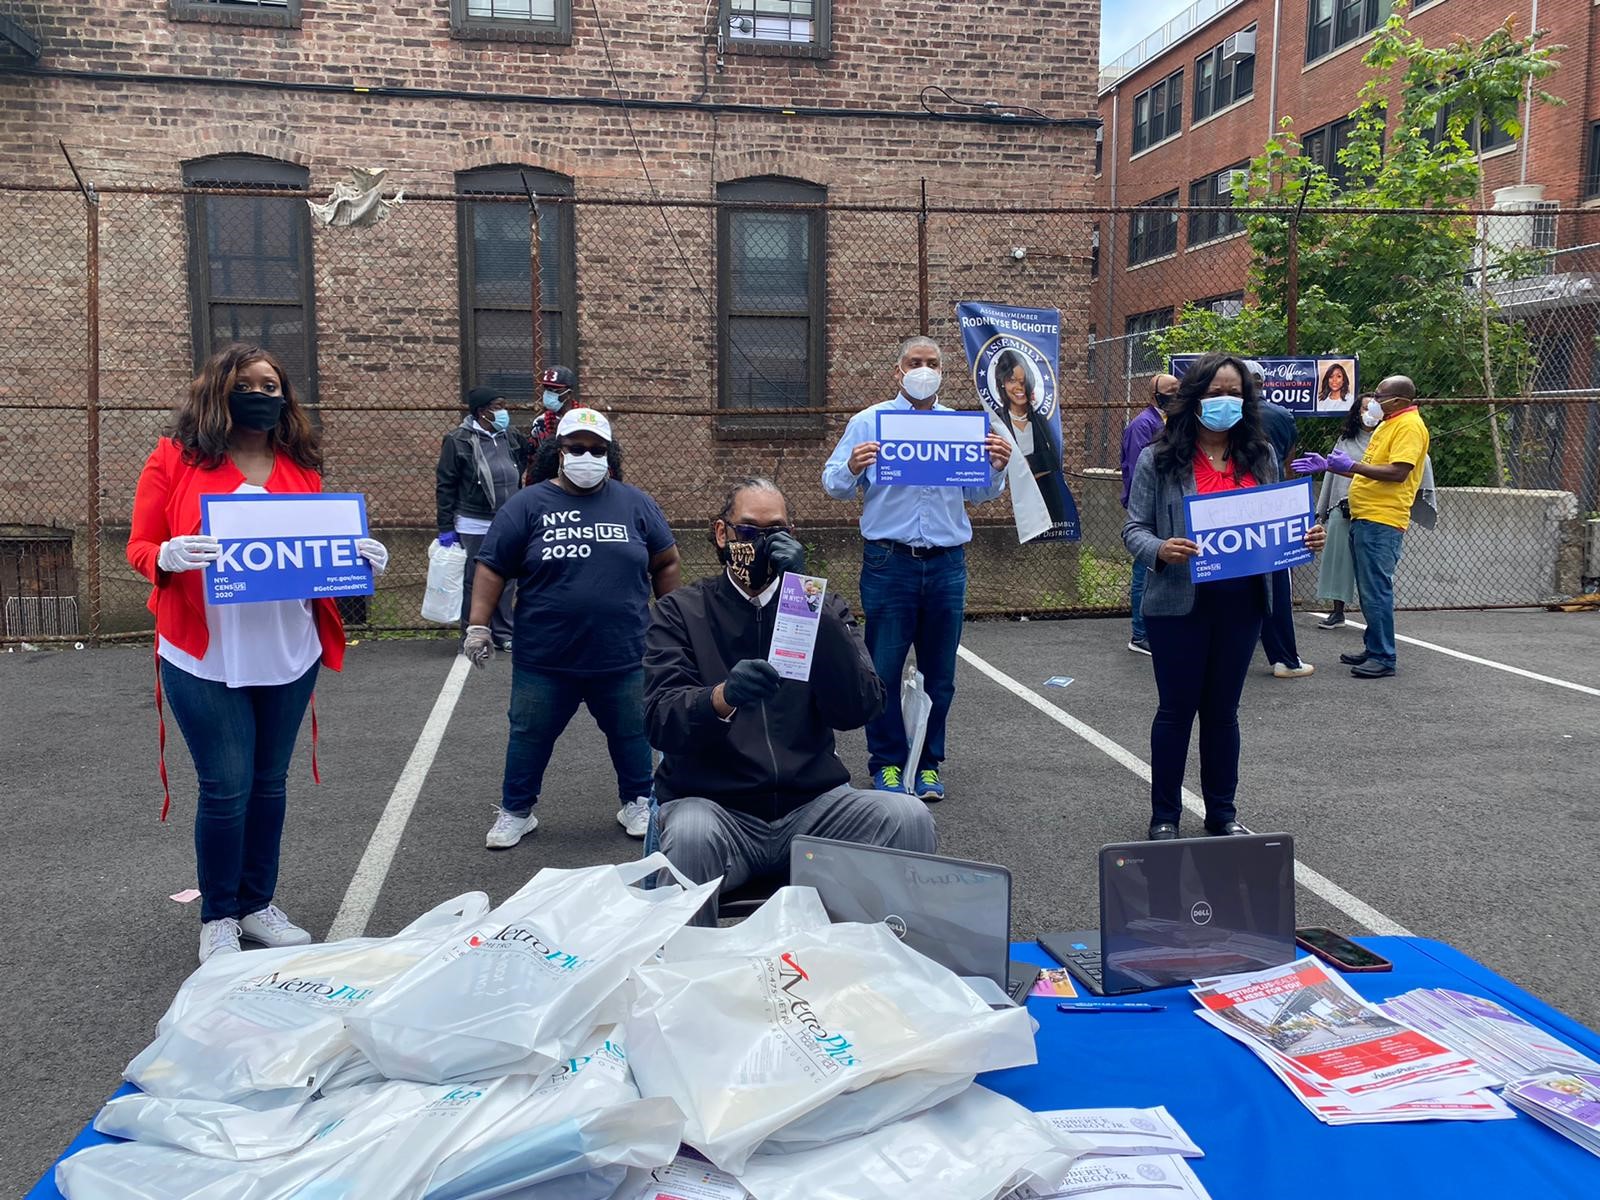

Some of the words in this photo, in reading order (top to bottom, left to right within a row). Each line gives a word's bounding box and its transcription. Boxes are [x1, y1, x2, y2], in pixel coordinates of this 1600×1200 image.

[979, 308, 1038, 320] ASSEMBLYMEMBER
[962, 316, 1011, 329] RODNEYSE
[1011, 320, 1058, 334] BICHOTTE
[985, 338, 1044, 362] ASSEMBLY
[880, 442, 986, 463] COUNTS!
[542, 510, 582, 527] NYC
[542, 523, 629, 542] CENSUS
[1195, 516, 1309, 558] KONTE!
[217, 538, 364, 573] KONTE!
[541, 544, 592, 561] 2020
[214, 582, 246, 592] CENSUS
[313, 583, 368, 593] #GetCountedNYC
[326, 575, 367, 584] nyc.gov/nocc
[783, 587, 795, 595] LIVE
[1193, 907, 1210, 918] DELL
